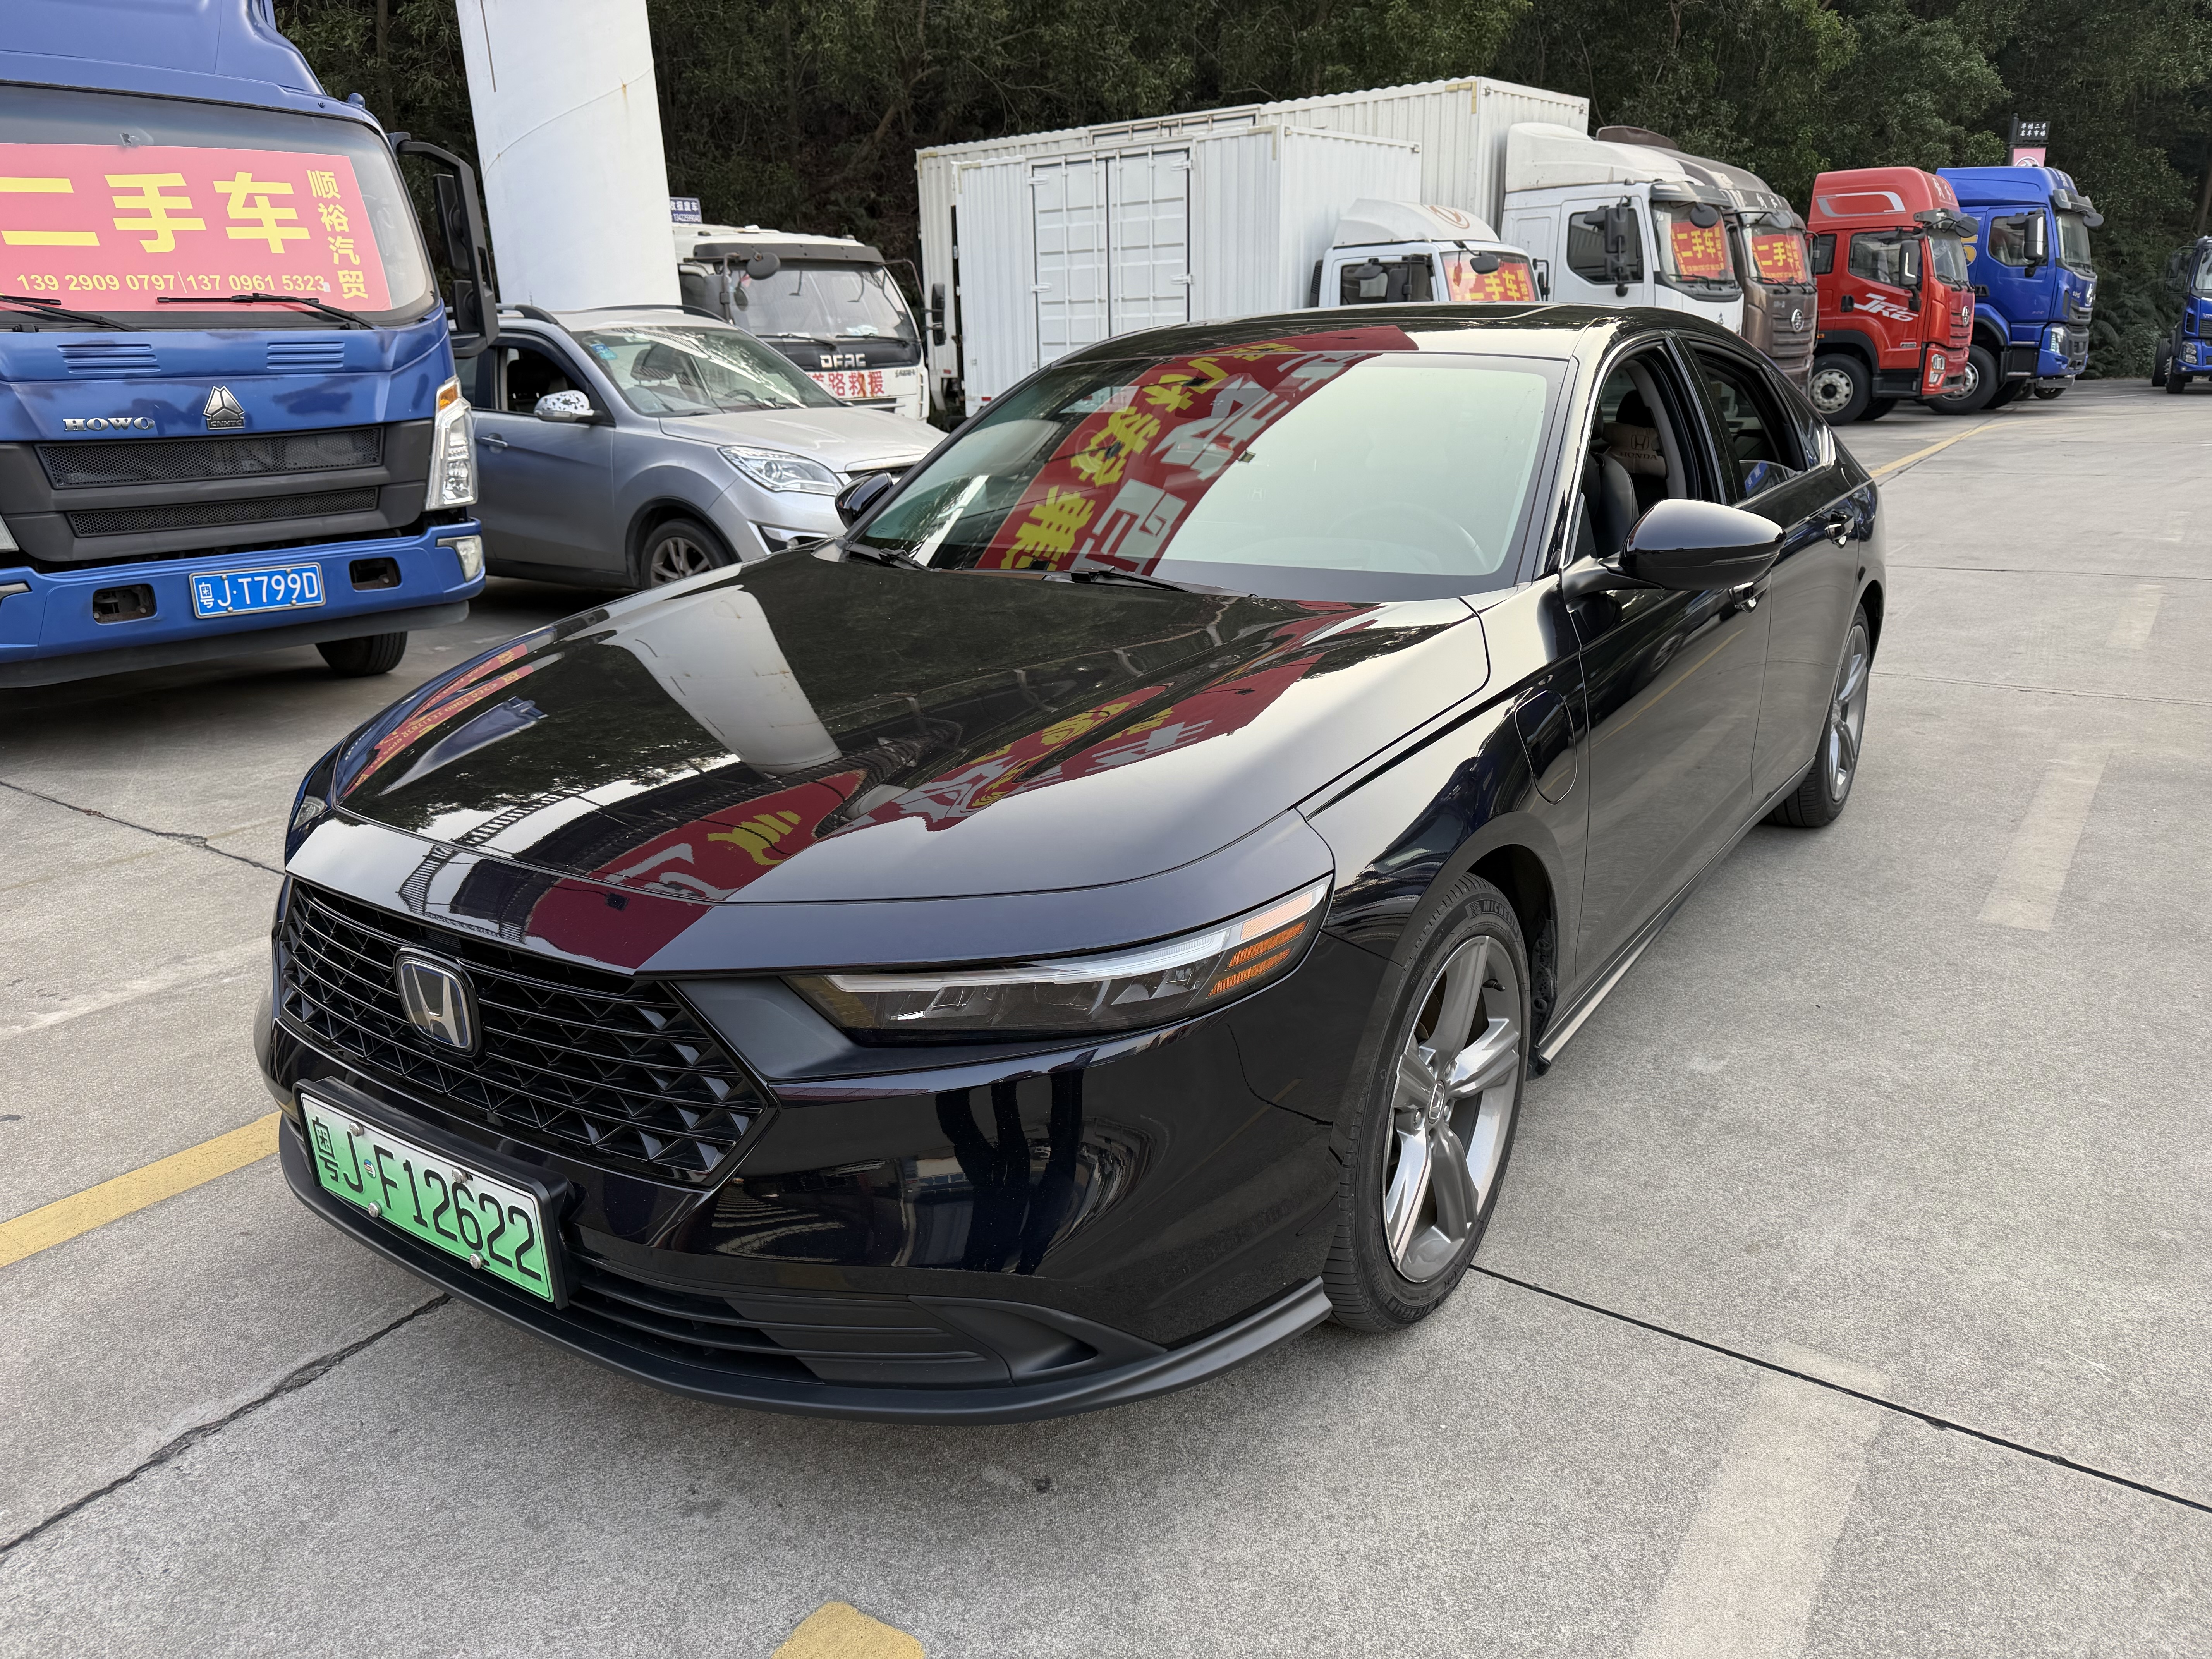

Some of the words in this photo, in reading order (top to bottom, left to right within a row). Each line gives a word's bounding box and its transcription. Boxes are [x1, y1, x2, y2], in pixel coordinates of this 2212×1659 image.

[0, 172, 311, 253] 二手车
[306, 170, 369, 299] 顺裕汽贸
[1677, 228, 1716, 259] 二手车
[17, 274, 59, 290] 139
[65, 275, 120, 291] 2909
[125, 274, 174, 290] 0797
[187, 275, 221, 291] 137
[228, 275, 275, 291] 0961
[282, 275, 325, 291] 5323
[820, 353, 867, 368] DFAC
[63, 417, 155, 431] HOWO
[1620, 452, 1658, 460] HONDA
[1483, 900, 1518, 934] MICHELIN
